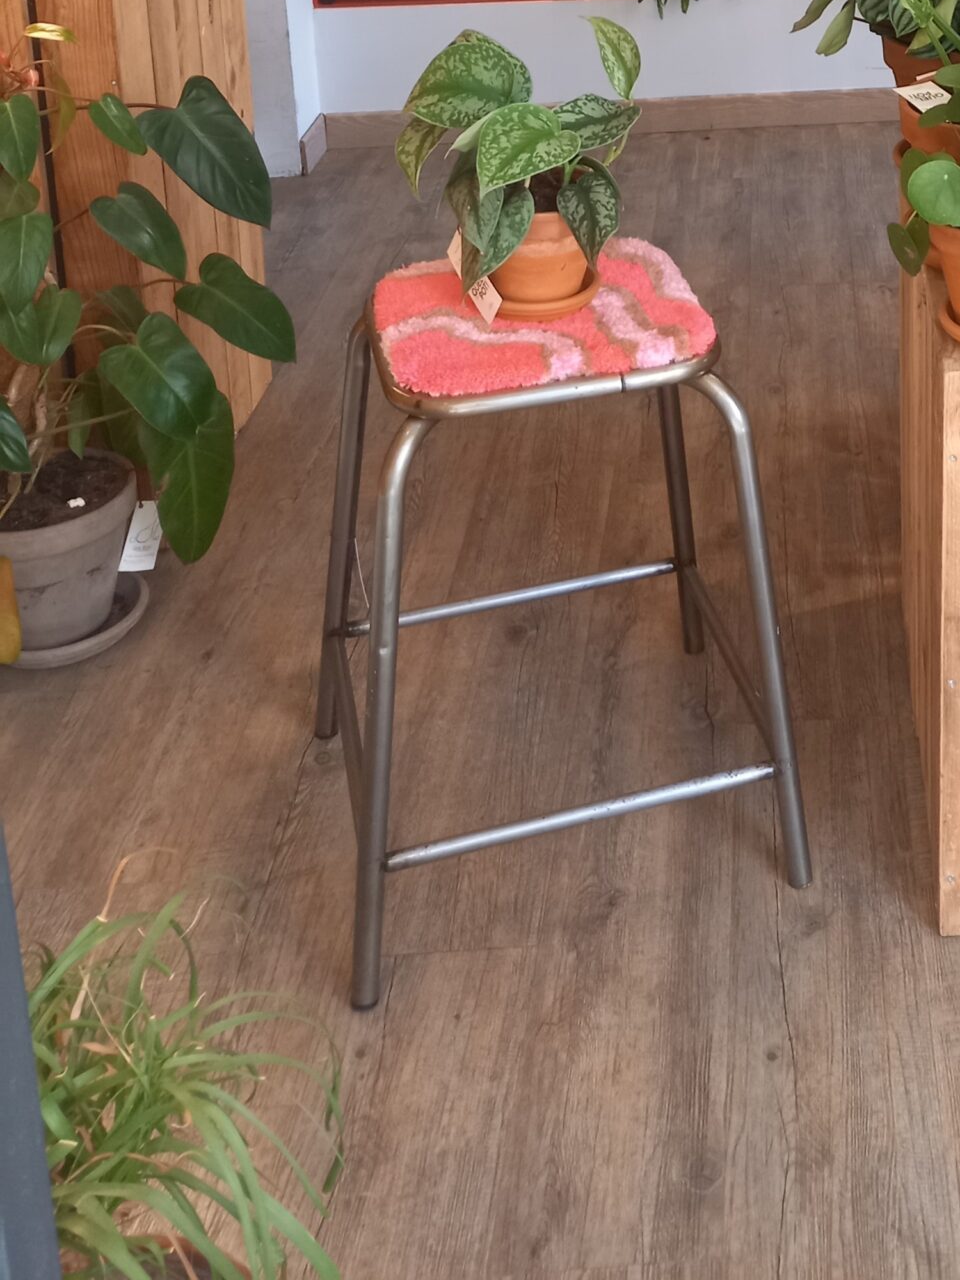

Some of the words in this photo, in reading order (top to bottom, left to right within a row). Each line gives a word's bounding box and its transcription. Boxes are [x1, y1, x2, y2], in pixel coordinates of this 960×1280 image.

[908, 90, 932, 100] POT!
[919, 92, 944, 102] QUEL
[478, 281, 491, 299] POT!
